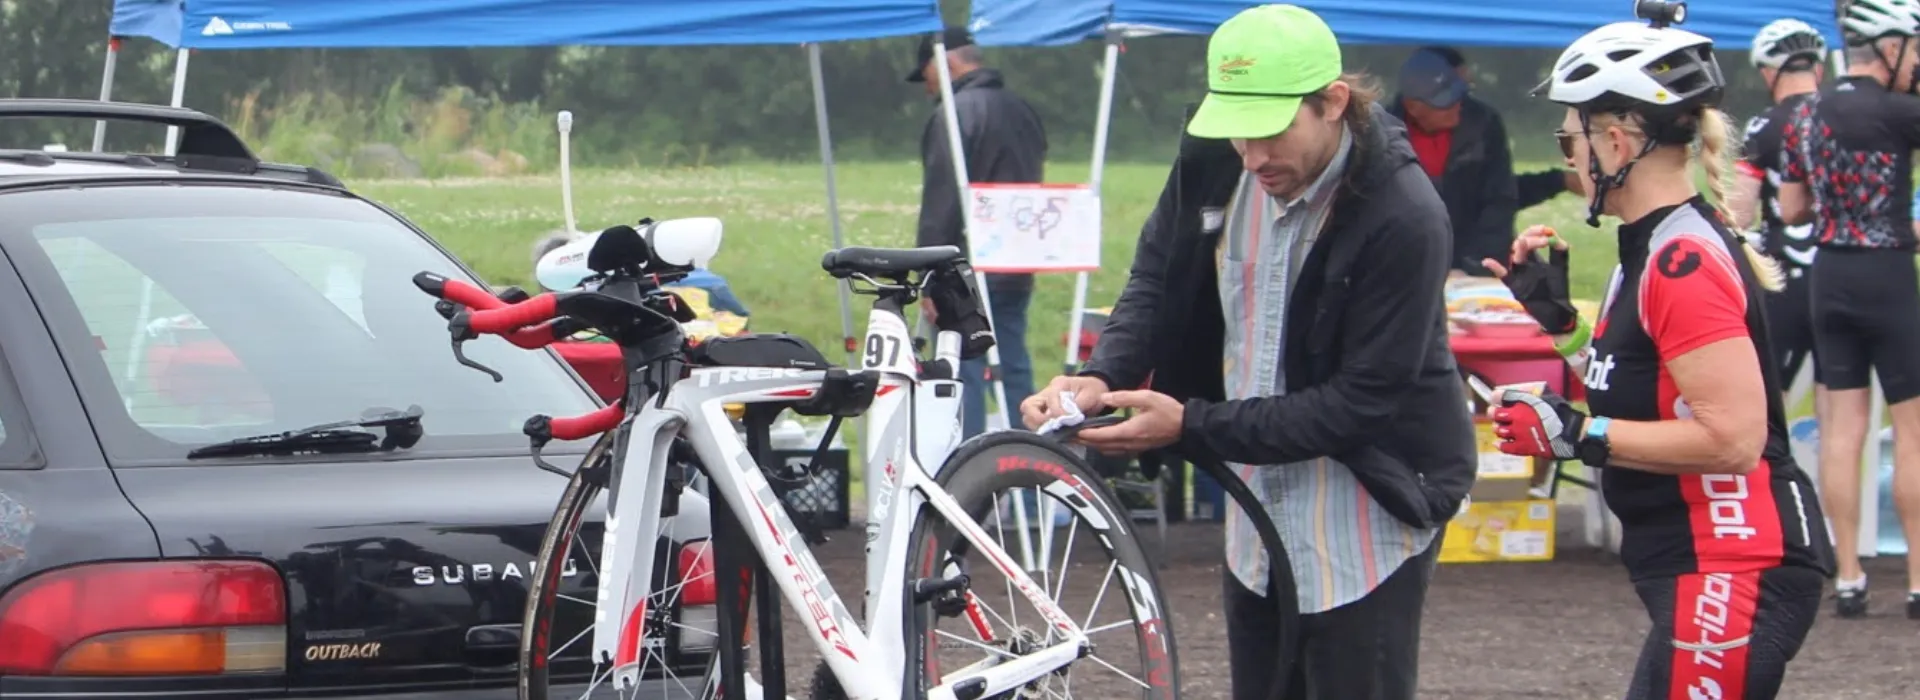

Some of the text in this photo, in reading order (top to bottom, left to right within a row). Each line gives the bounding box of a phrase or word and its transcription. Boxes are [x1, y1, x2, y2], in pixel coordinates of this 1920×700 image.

[865, 333, 901, 368] 97
[690, 366, 806, 388] TREK
[1701, 474, 1757, 540] Dot
[1693, 572, 1733, 670] TriDo
[305, 642, 381, 661] OUTBACK
